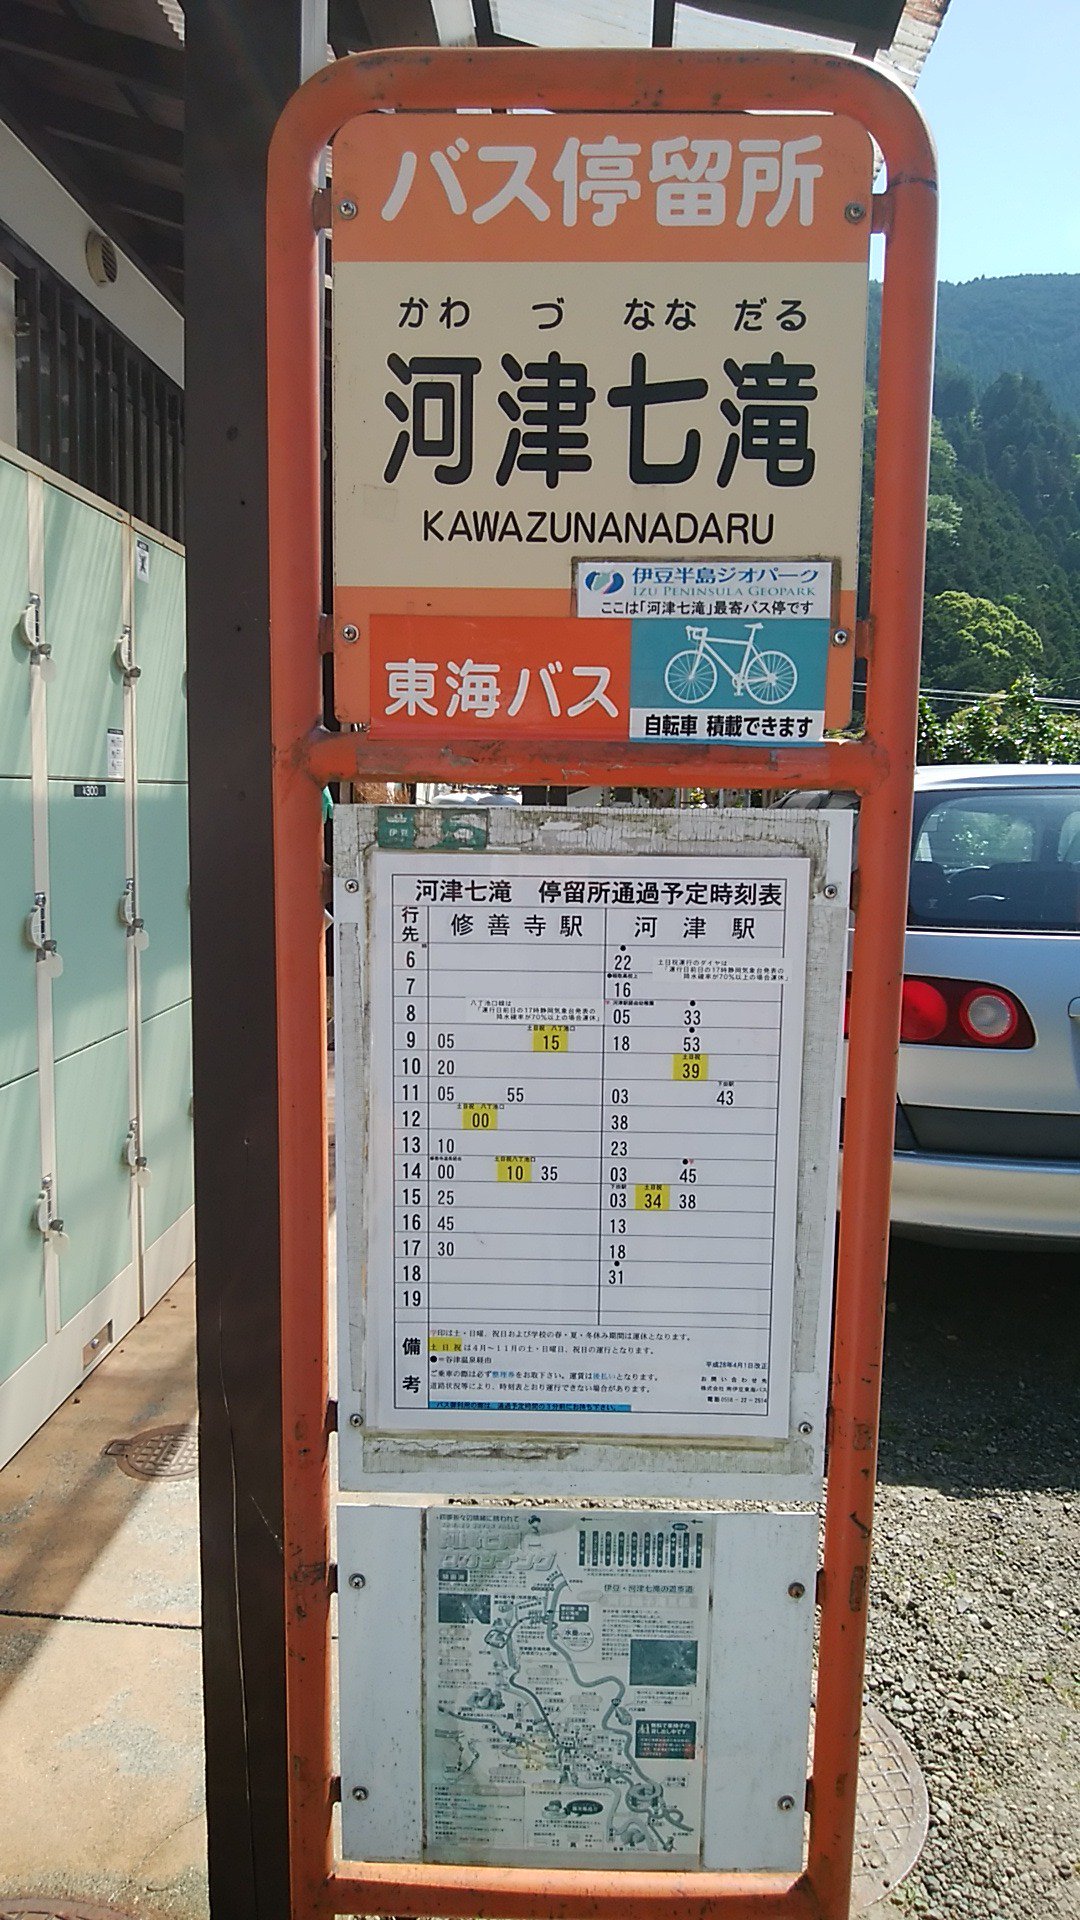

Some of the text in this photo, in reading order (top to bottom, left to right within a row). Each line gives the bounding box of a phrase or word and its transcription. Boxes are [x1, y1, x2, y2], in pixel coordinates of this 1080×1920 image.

[381, 134, 823, 228] バス停留所
[398, 296, 808, 331] かわ づ なな だる
[383, 350, 819, 489] 河津七滝
[422, 509, 775, 545] KAWAZUNANADARU
[632, 566, 819, 584] 伊豆半島ジオパーク
[632, 585, 816, 597] IZU PENINSULA GEOPARK
[601, 601, 814, 615] ここは「河津七滝」最寄バス停です
[384, 659, 619, 718] 東海バス
[644, 715, 814, 738] 自転車 積載できます
[415, 879, 782, 906] 河津七滝 停留所通過予定時刻表
[402, 906, 419, 942] 行先
[450, 913, 755, 939] 修善寺駅 河津駅
[406, 951, 632, 971] 6 22
[406, 978, 631, 998] 7 16
[406, 1004, 701, 1026] 8 05 33
[406, 1031, 700, 1052] 9 05 15 18 53
[402, 1057, 700, 1079] 10 20 39
[402, 1084, 734, 1106] 11 05 55 03 43
[402, 1110, 628, 1130] 12 00 38
[402, 1137, 627, 1156] 13 10 23
[402, 1162, 697, 1184] 14 00 10 35 03 45
[403, 1188, 696, 1209] 15 25 03 34 38
[403, 1214, 626, 1234] 16 45 13
[403, 1240, 626, 1259] 17 30 18
[403, 1265, 623, 1285] 18 31
[403, 1290, 421, 1307] 19
[402, 1337, 421, 1394] 備考
